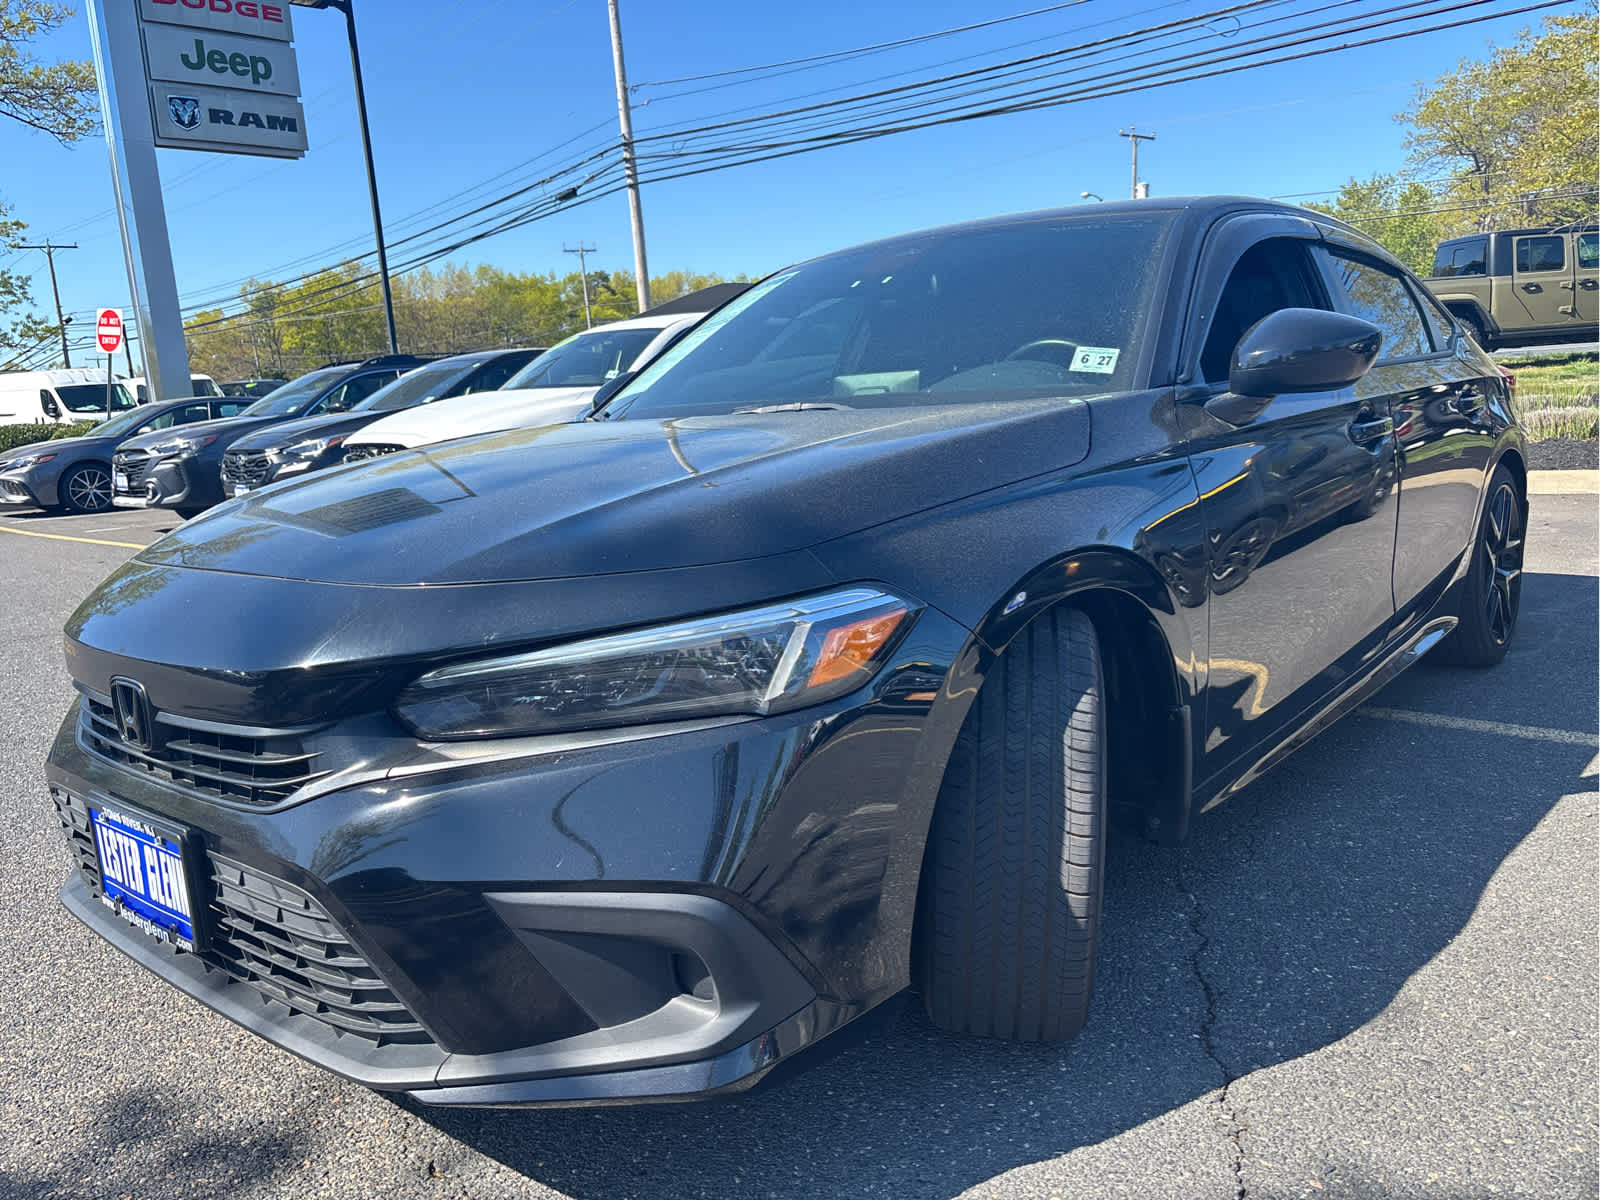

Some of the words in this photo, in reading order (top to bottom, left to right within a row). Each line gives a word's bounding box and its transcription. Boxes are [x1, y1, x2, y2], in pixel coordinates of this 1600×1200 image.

[180, 38, 273, 85] Jeep
[208, 108, 298, 133] RAM
[1081, 354, 1090, 364] 6
[1096, 355, 1113, 366] 27
[95, 823, 145, 896] LESTER
[143, 844, 191, 919] GLENN
